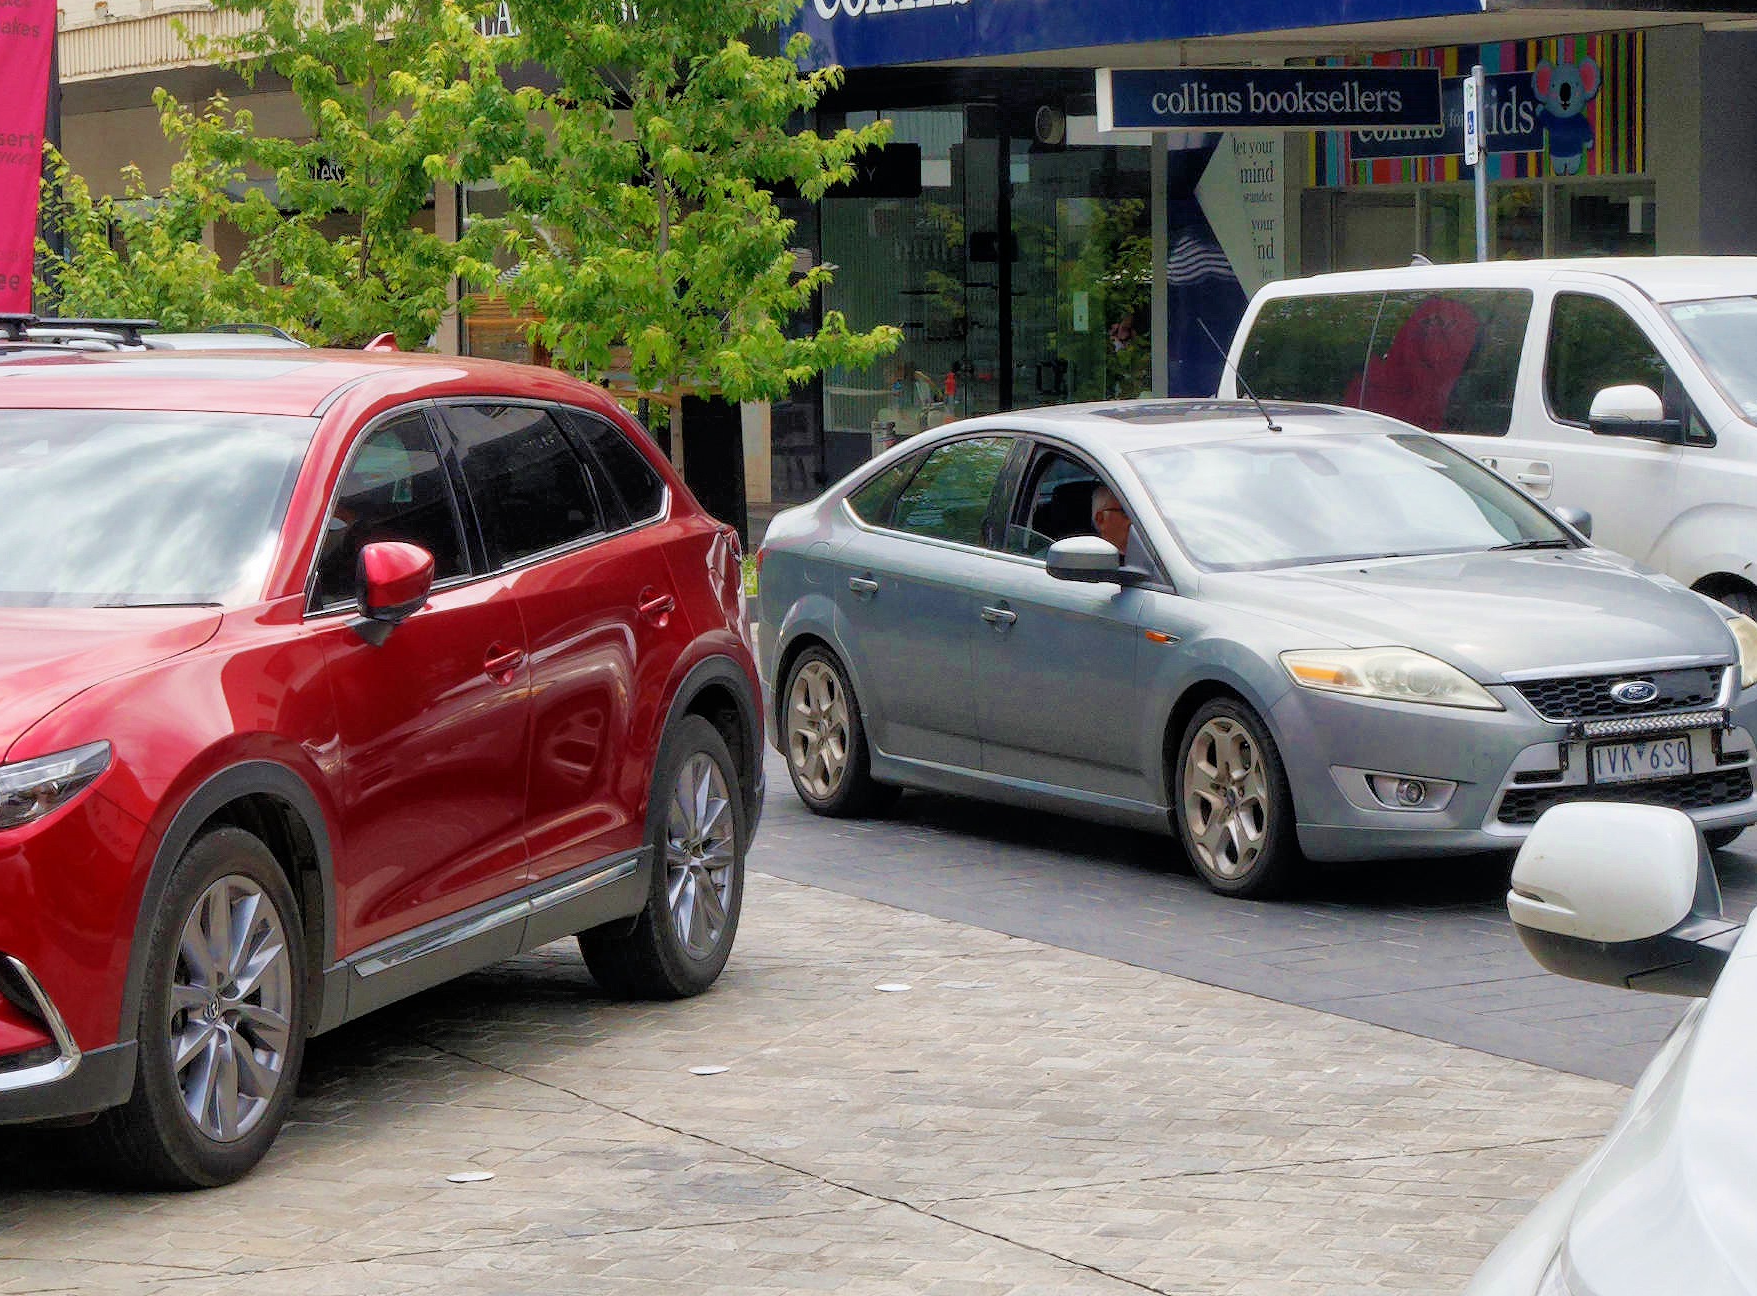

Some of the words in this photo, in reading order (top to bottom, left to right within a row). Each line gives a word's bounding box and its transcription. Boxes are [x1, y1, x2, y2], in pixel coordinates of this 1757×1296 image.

[1151, 82, 1243, 116] collins
[1245, 81, 1403, 115] booksellers
[1240, 160, 1275, 183] mind
